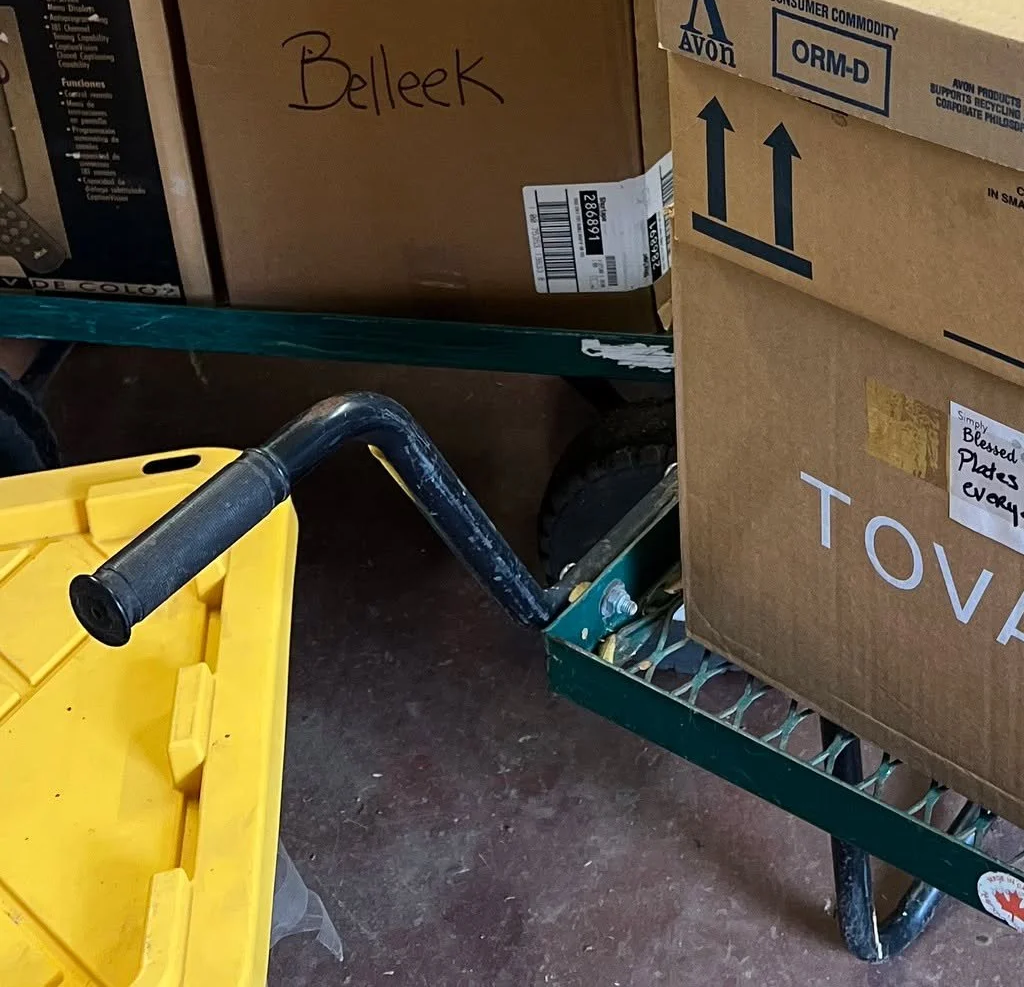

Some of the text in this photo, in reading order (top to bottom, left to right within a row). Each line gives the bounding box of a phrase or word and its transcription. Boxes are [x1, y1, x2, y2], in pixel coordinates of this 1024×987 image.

[831, 7, 899, 41] COMMODITY
[281, 30, 505, 117] Belleek
[791, 39, 870, 85] ORM-D
[929, 82, 972, 105] SUPPORTS
[974, 97, 1021, 120] RECYCLING
[935, 96, 983, 120] CORPORATE
[952, 78, 1021, 109] AVON PRODUCTS
[987, 187, 999, 200] IN
[582, 194, 601, 242] 286891
[31, 279, 65, 290] DE
[957, 410, 988, 434] Simply
[963, 426, 1018, 464] Blessed
[958, 447, 1019, 491] Plates
